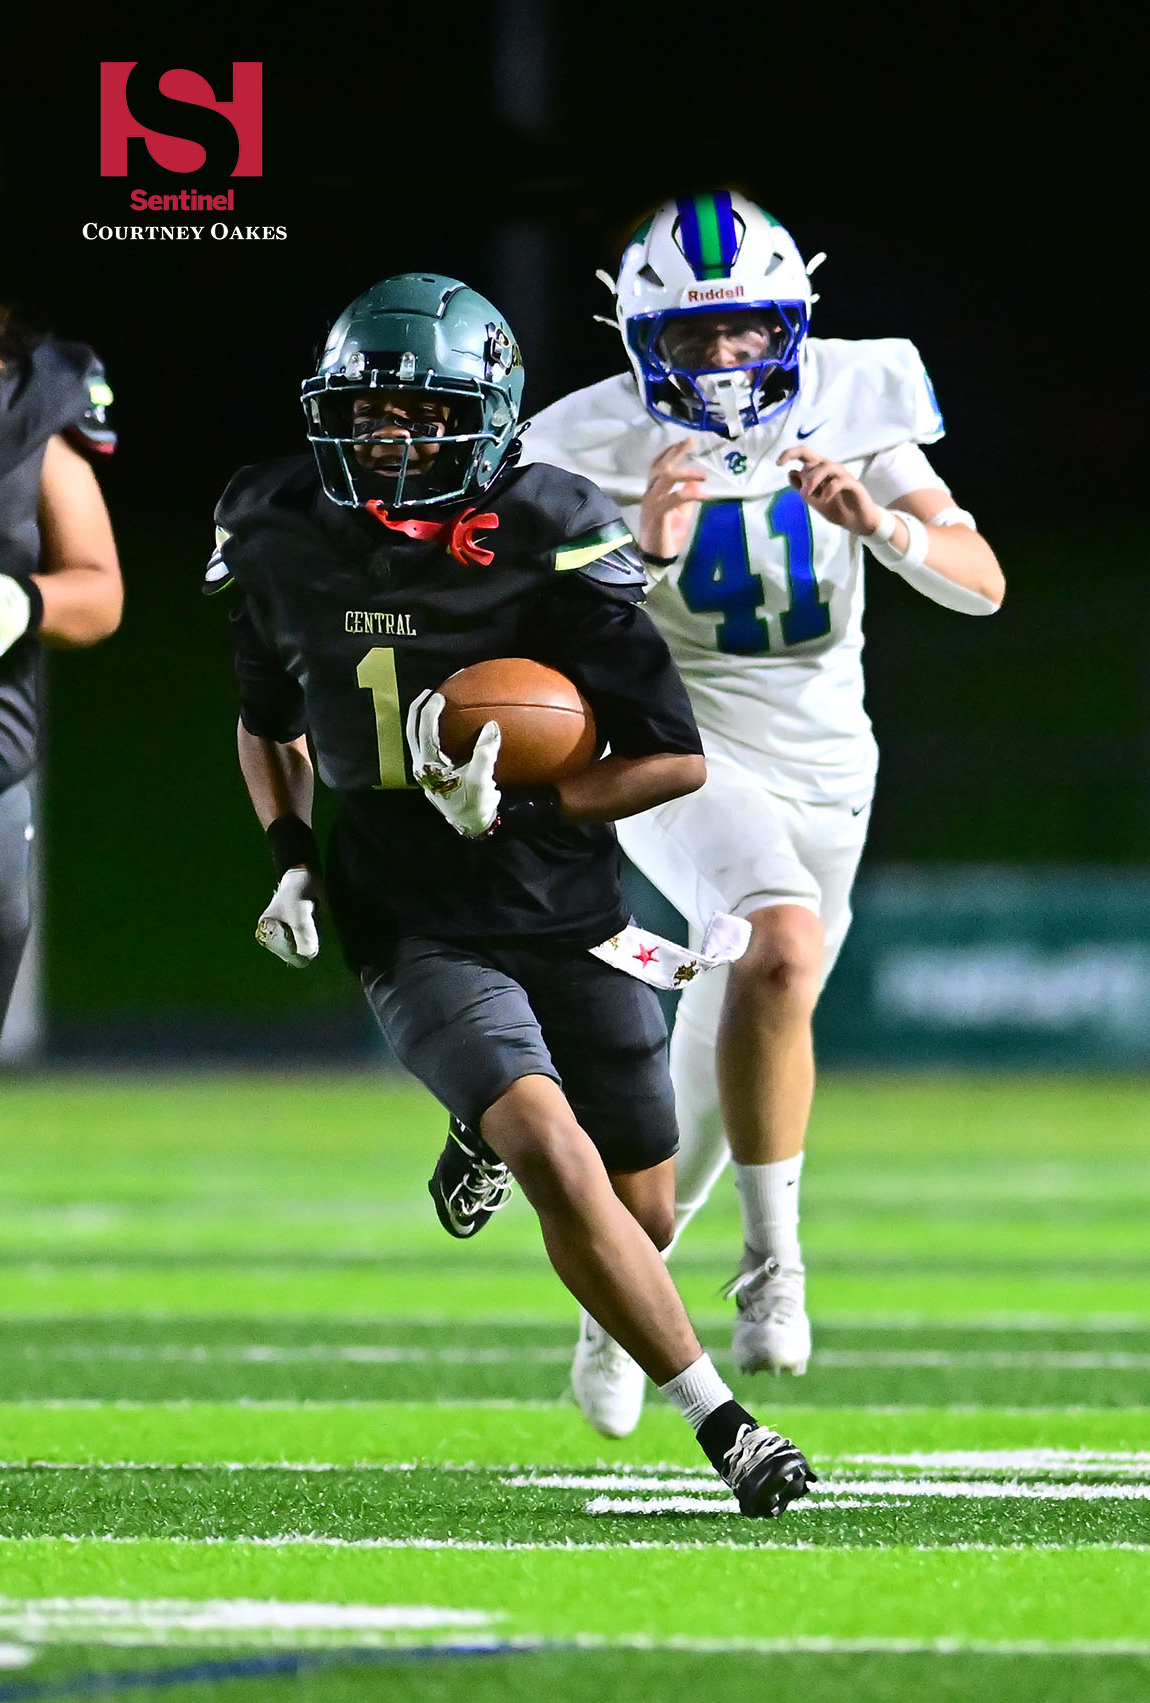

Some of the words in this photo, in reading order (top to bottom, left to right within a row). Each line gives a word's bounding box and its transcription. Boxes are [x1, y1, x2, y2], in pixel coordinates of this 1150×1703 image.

[688, 285, 745, 302] Riddell
[677, 489, 832, 656] 41
[345, 611, 417, 636] CENTRAL
[356, 647, 420, 789] 1
